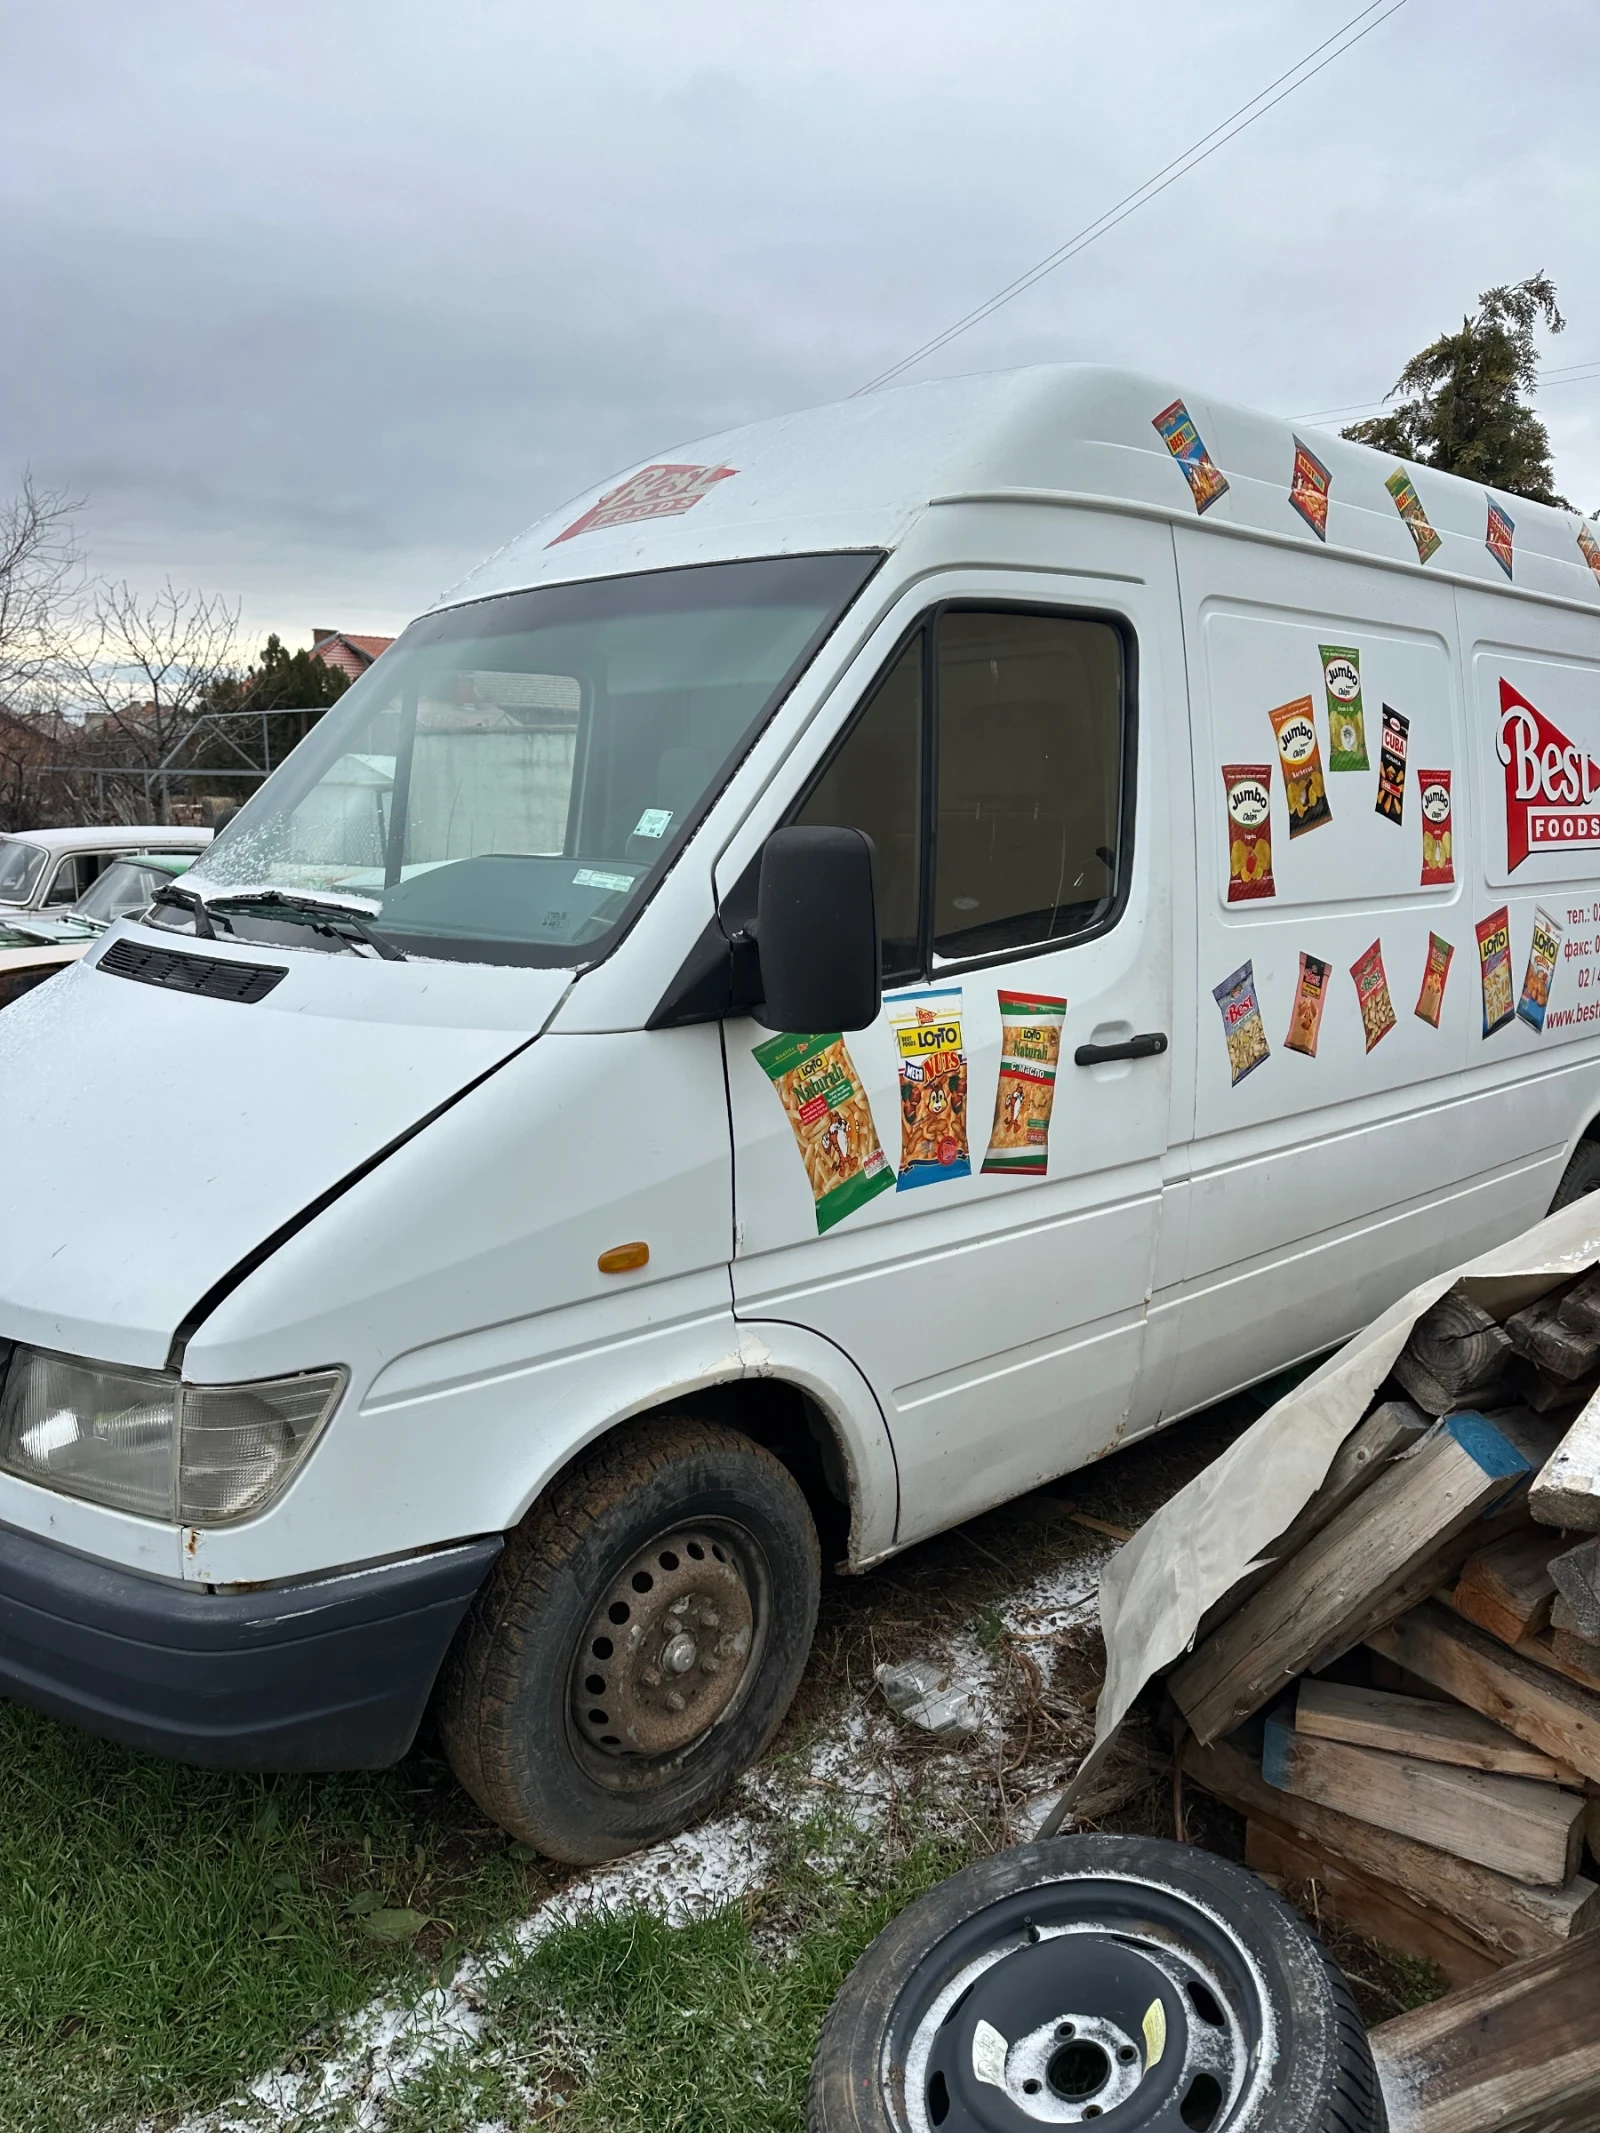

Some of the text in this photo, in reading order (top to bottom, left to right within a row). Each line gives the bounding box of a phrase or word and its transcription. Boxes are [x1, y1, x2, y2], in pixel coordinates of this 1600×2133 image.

[600, 458, 732, 511] Best
[597, 497, 696, 525] FOODS
[1328, 665, 1358, 686] Jumbo
[1281, 721, 1313, 751] Jumbo
[1384, 732, 1405, 755] CUBA
[1496, 705, 1597, 804] Best
[1232, 786, 1267, 811] Jumbo
[1424, 789, 1448, 809] Jumbo
[1535, 818, 1600, 838] FOODS
[1567, 908, 1590, 925] тел.:
[1482, 931, 1506, 957] LOTTO
[1534, 930, 1556, 959] LOTTO
[1564, 938, 1592, 963] факс:
[1225, 995, 1254, 1024] Best
[1547, 999, 1600, 1030] www.best
[917, 1027, 958, 1049] LOTTO
[1023, 1029, 1042, 1042] LOTTO
[1013, 1040, 1049, 1060] Naturali
[801, 1058, 824, 1077] LOTTO
[923, 1051, 960, 1081] NUTS
[1018, 1065, 1045, 1079] масло
[792, 1061, 846, 1106] Naturali
